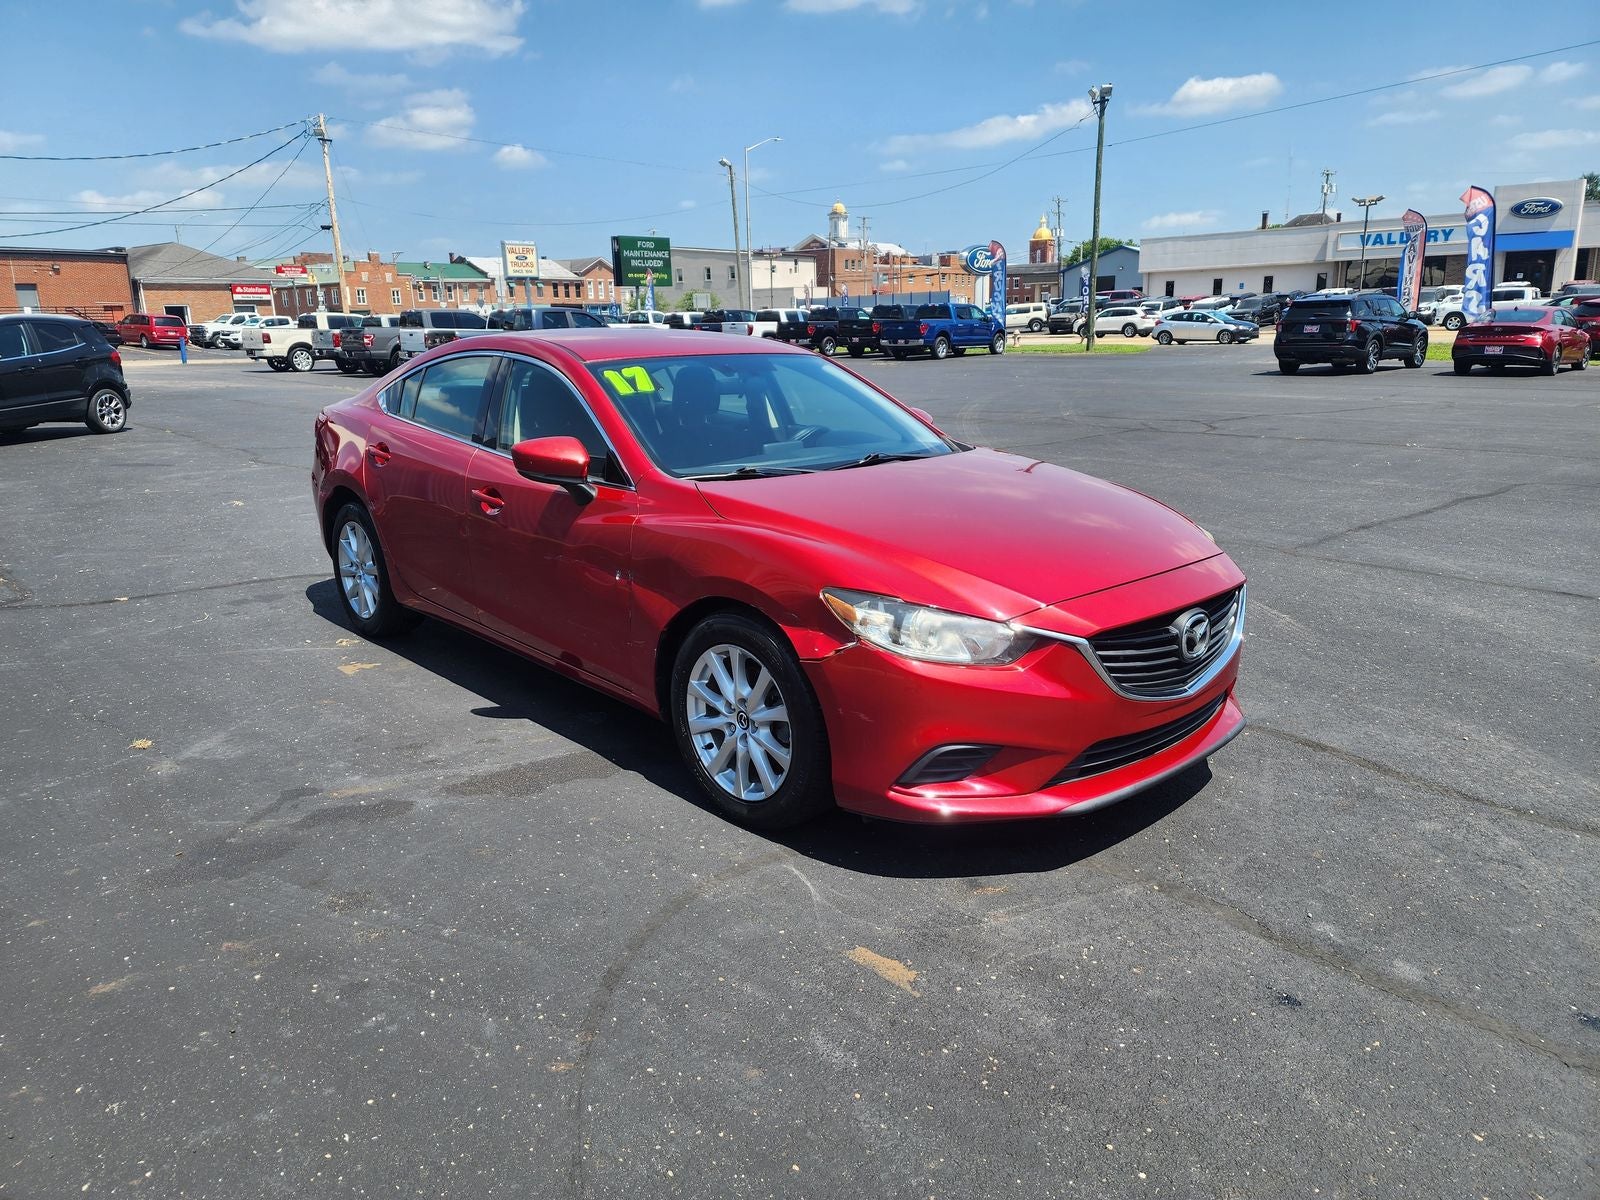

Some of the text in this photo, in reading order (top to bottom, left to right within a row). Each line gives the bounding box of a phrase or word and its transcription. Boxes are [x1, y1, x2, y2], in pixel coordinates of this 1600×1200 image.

[1520, 201, 1552, 214] Ford
[1360, 228, 1454, 247] VALLRY
[507, 247, 535, 255] VALLERY
[623, 250, 670, 258] MAINTENANCE
[630, 259, 664, 267] INCLUDED!
[973, 250, 993, 268] For
[603, 366, 655, 396] 17
